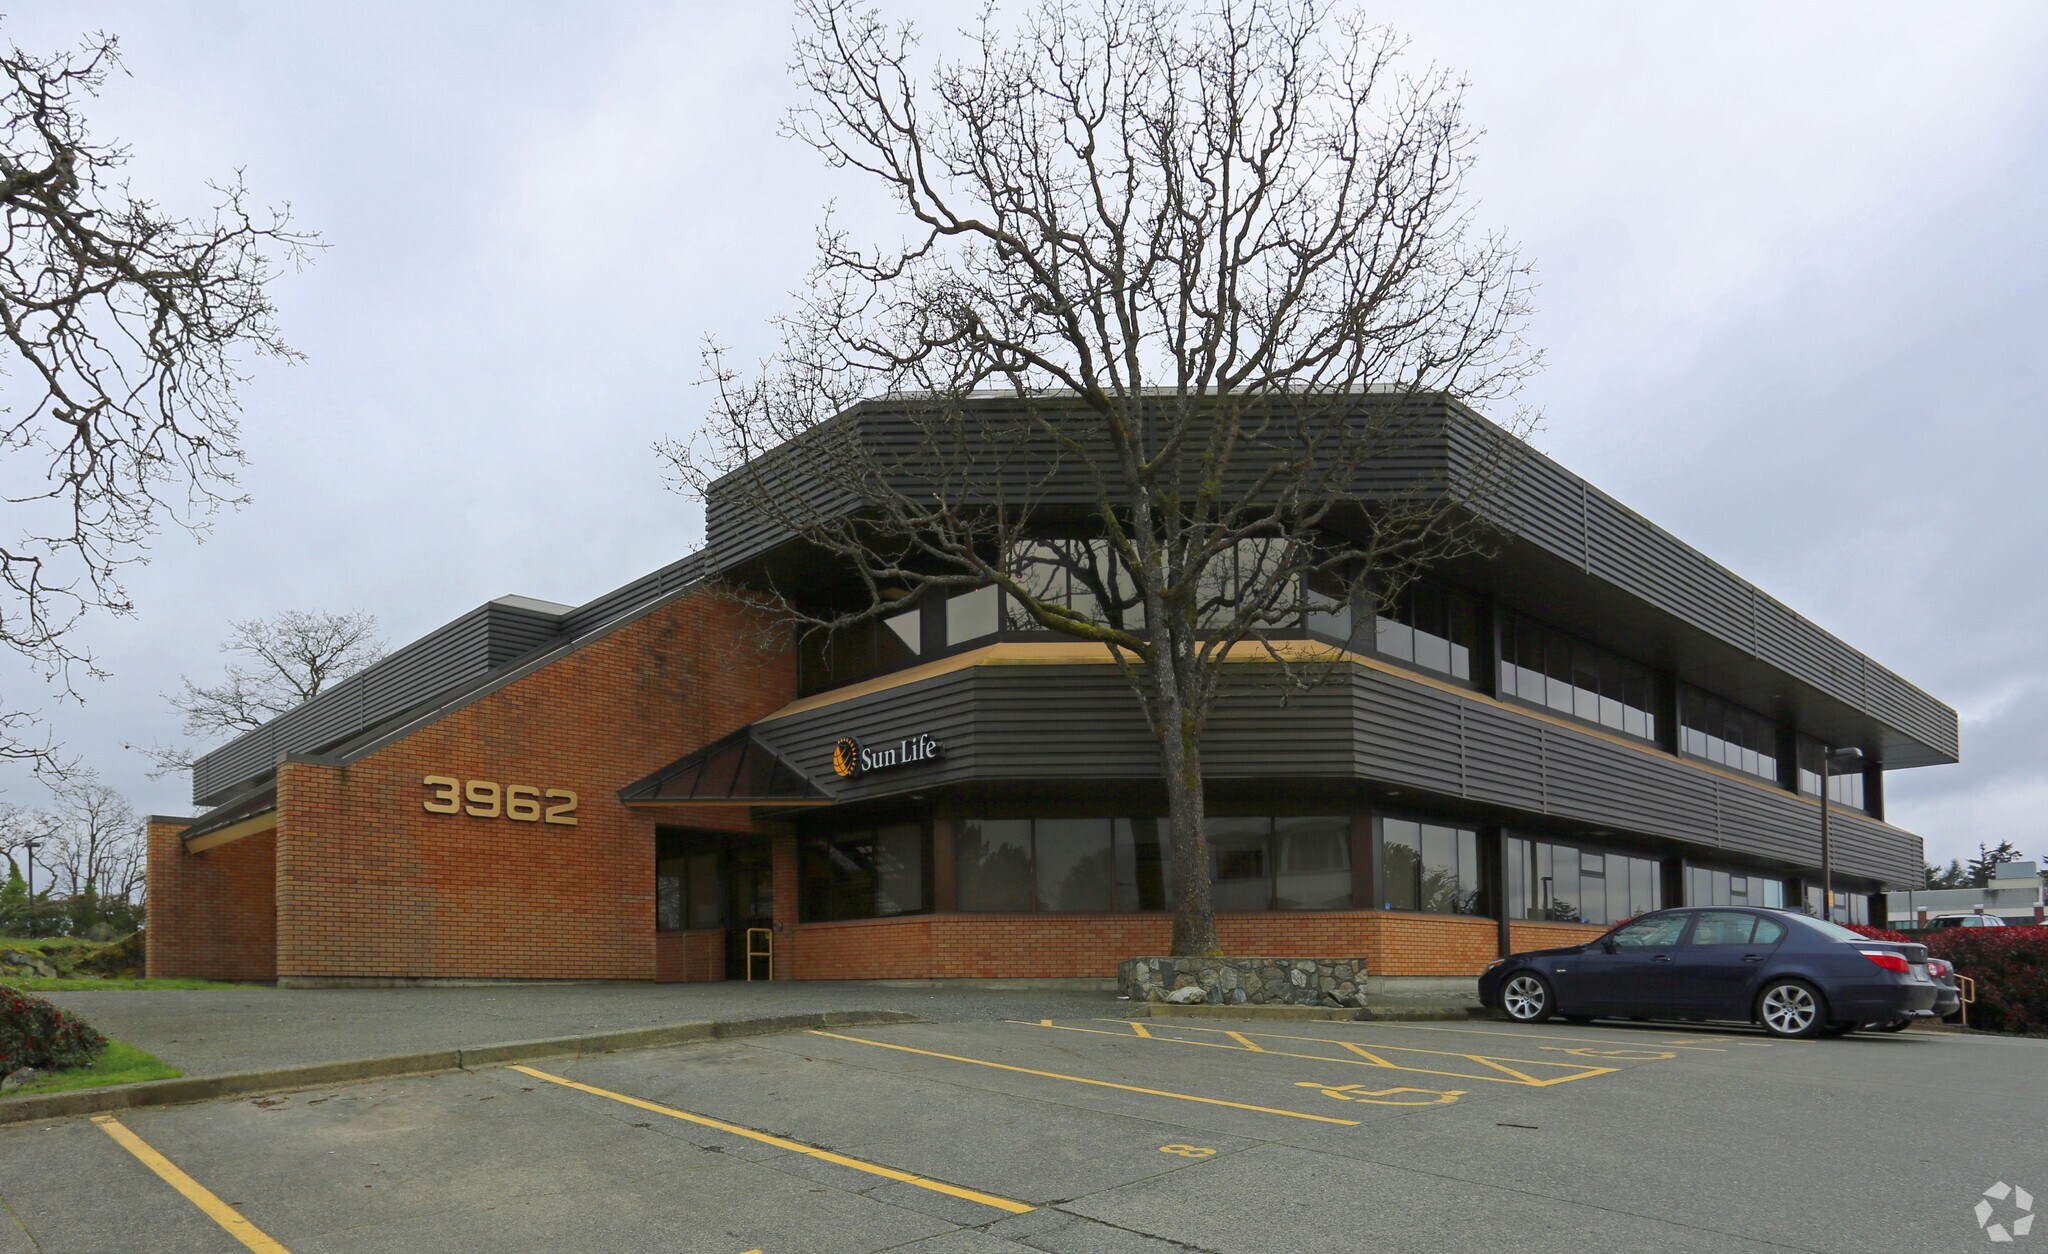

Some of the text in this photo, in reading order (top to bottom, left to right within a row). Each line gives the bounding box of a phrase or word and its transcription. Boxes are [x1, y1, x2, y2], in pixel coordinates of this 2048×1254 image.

[861, 733, 936, 771] Sun Life
[423, 775, 578, 826] 3962
